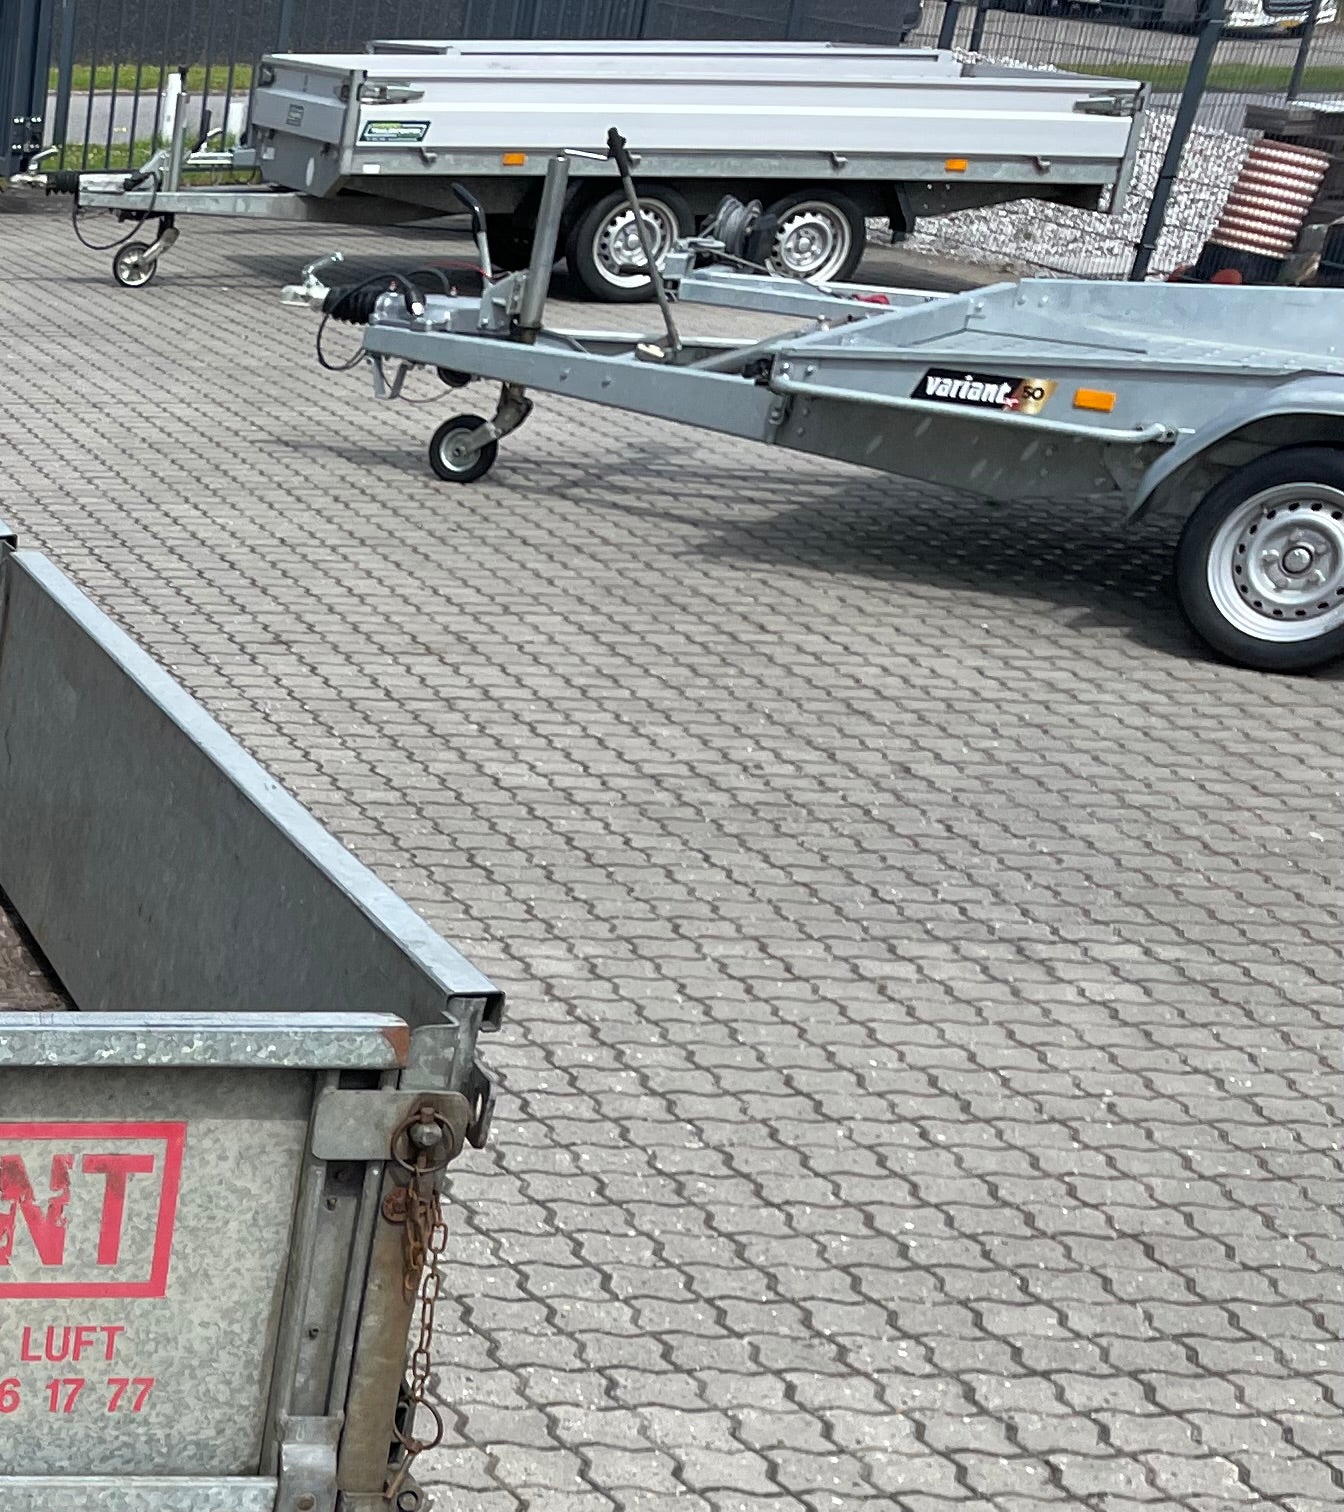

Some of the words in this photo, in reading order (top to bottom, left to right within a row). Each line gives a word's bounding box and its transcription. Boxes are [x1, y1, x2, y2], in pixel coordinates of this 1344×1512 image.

[925, 375, 1012, 404] variant
[1024, 386, 1046, 401] 50
[20, 1325, 125, 1363] LUFT
[46, 1378, 85, 1413] 17
[108, 1377, 155, 1412] 77
